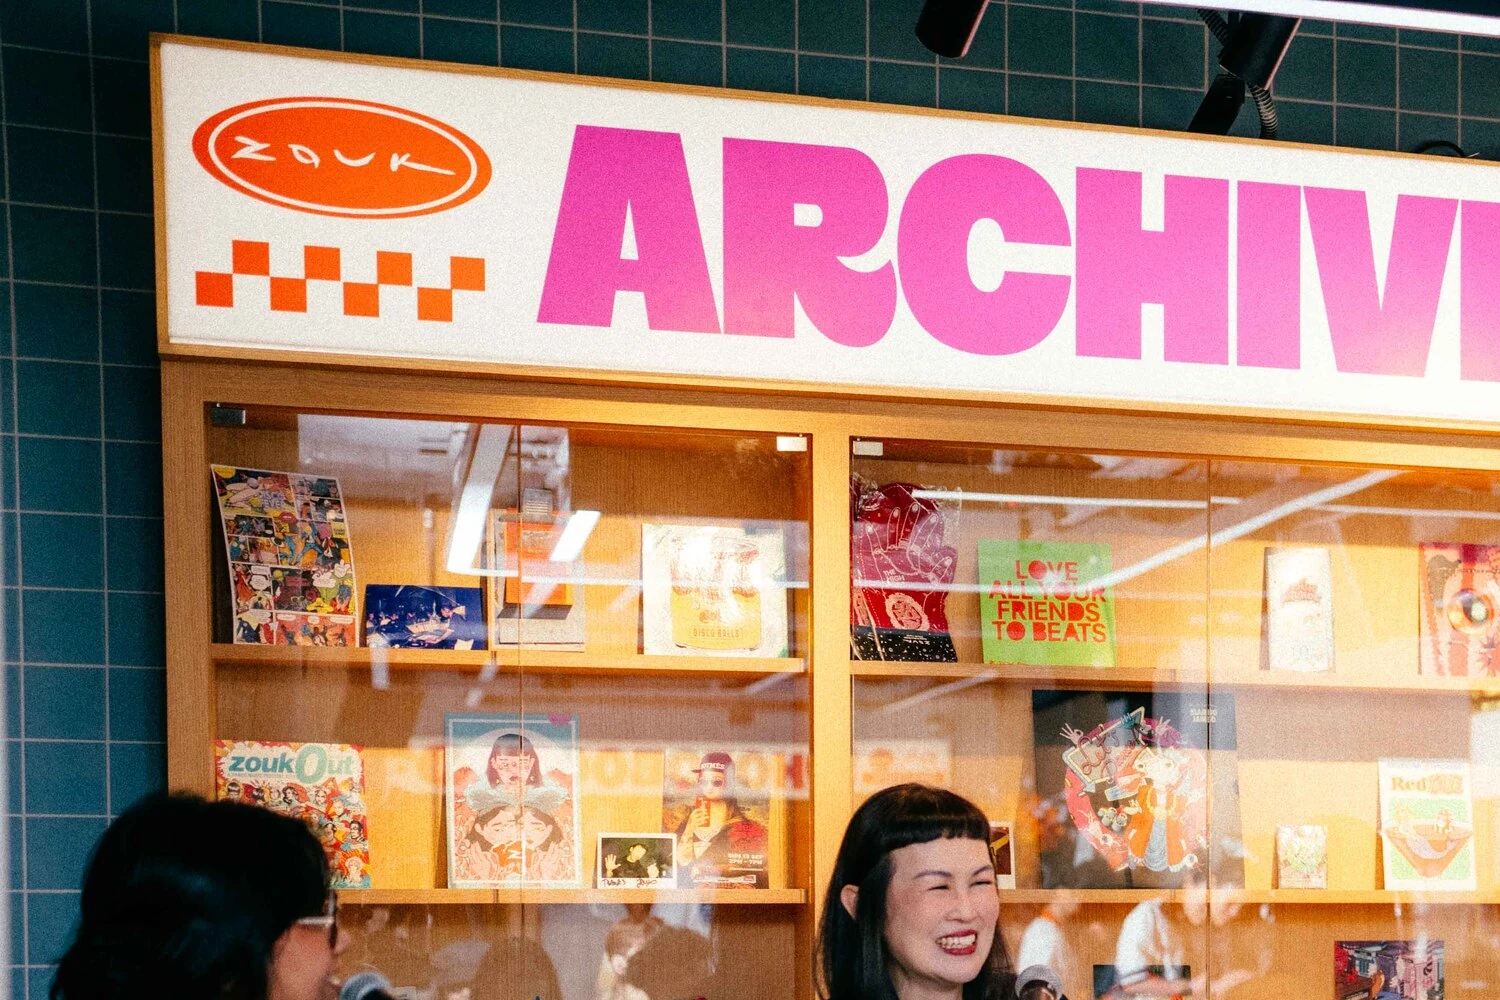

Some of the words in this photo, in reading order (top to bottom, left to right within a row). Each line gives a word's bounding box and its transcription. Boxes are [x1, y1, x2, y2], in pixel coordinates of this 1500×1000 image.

[1015, 560, 1078, 581] LOVE
[988, 579, 1034, 600] ALL
[1038, 581, 1107, 603] YOUR
[997, 600, 1101, 622] FRIENDS
[992, 620, 1026, 642] TO
[1032, 621, 1107, 643] BEATS
